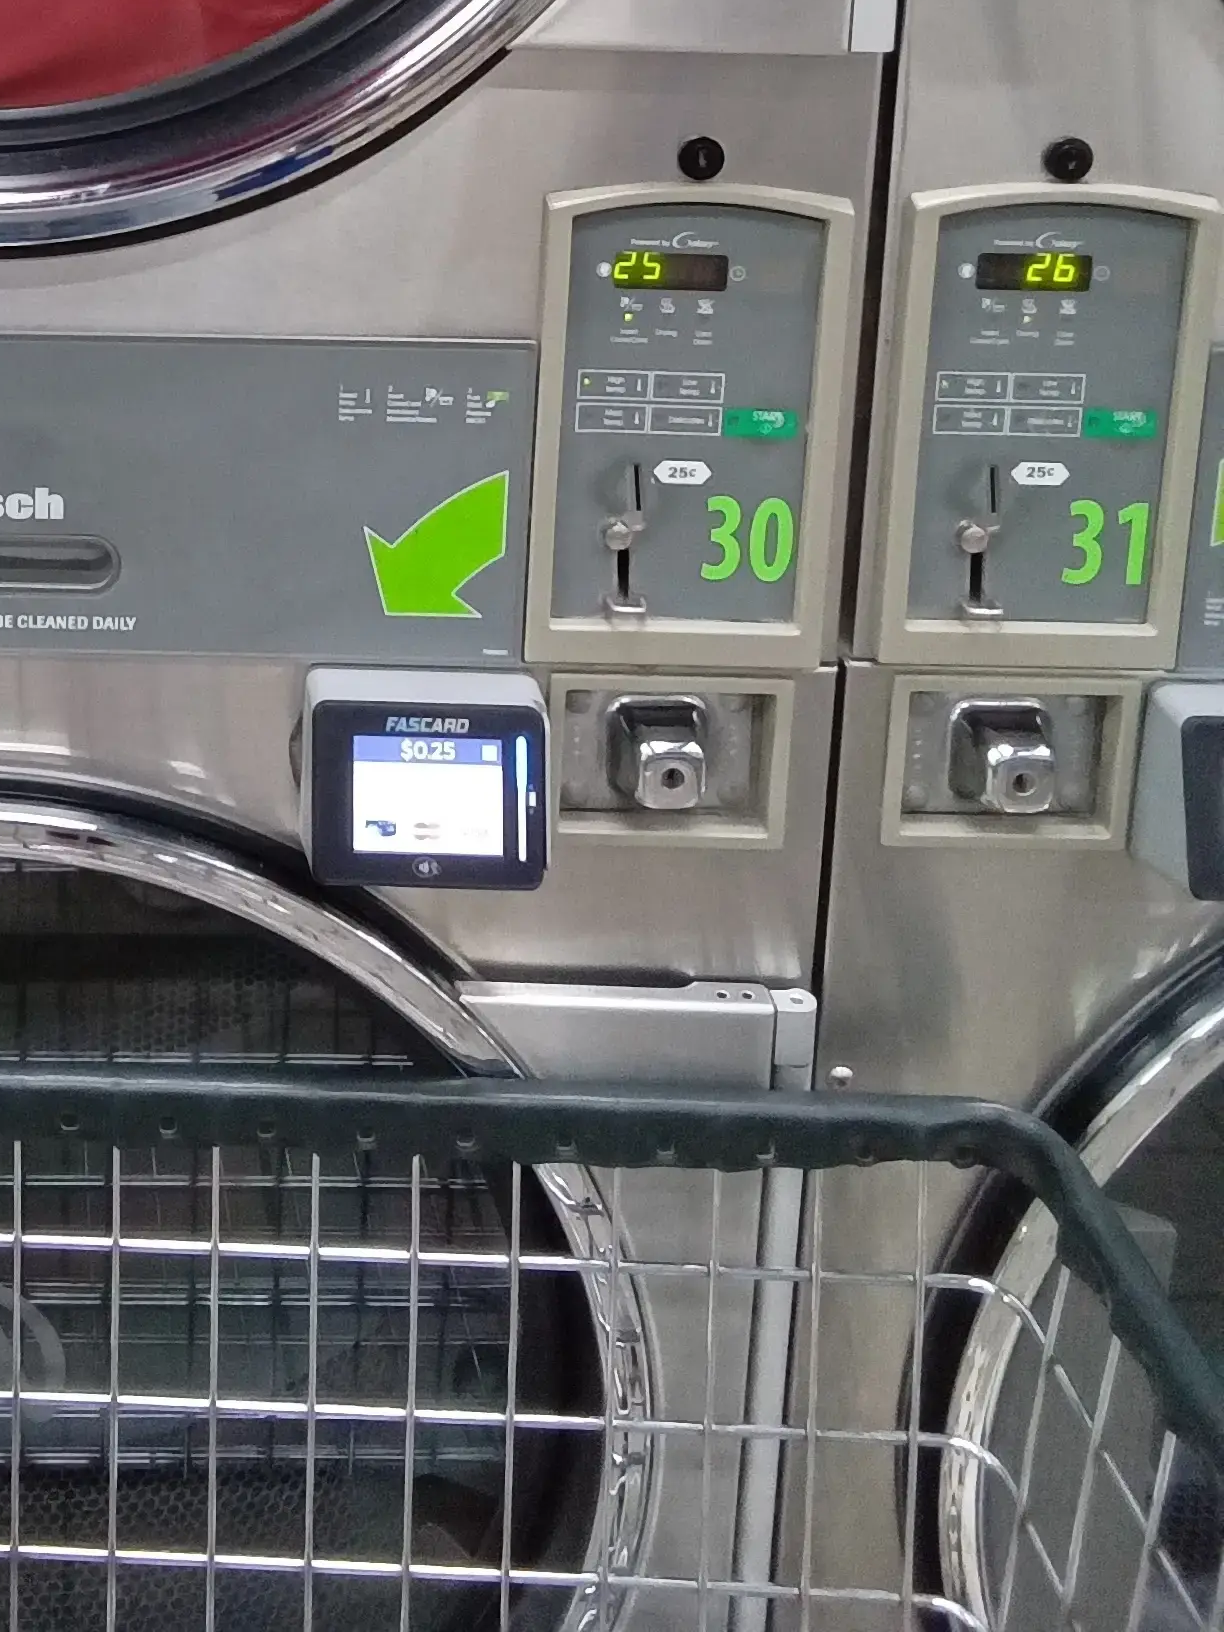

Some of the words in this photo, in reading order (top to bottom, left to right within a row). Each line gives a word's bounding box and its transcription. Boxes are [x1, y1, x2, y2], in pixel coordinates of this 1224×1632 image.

[613, 251, 661, 280] 25
[1026, 252, 1076, 282] 26
[700, 495, 794, 582] 30
[1061, 499, 1149, 585] 31
[17, 615, 89, 630] CLEANED
[92, 616, 137, 631] DAILY
[385, 716, 470, 734] FASCARD
[400, 737, 456, 762] $0.25
